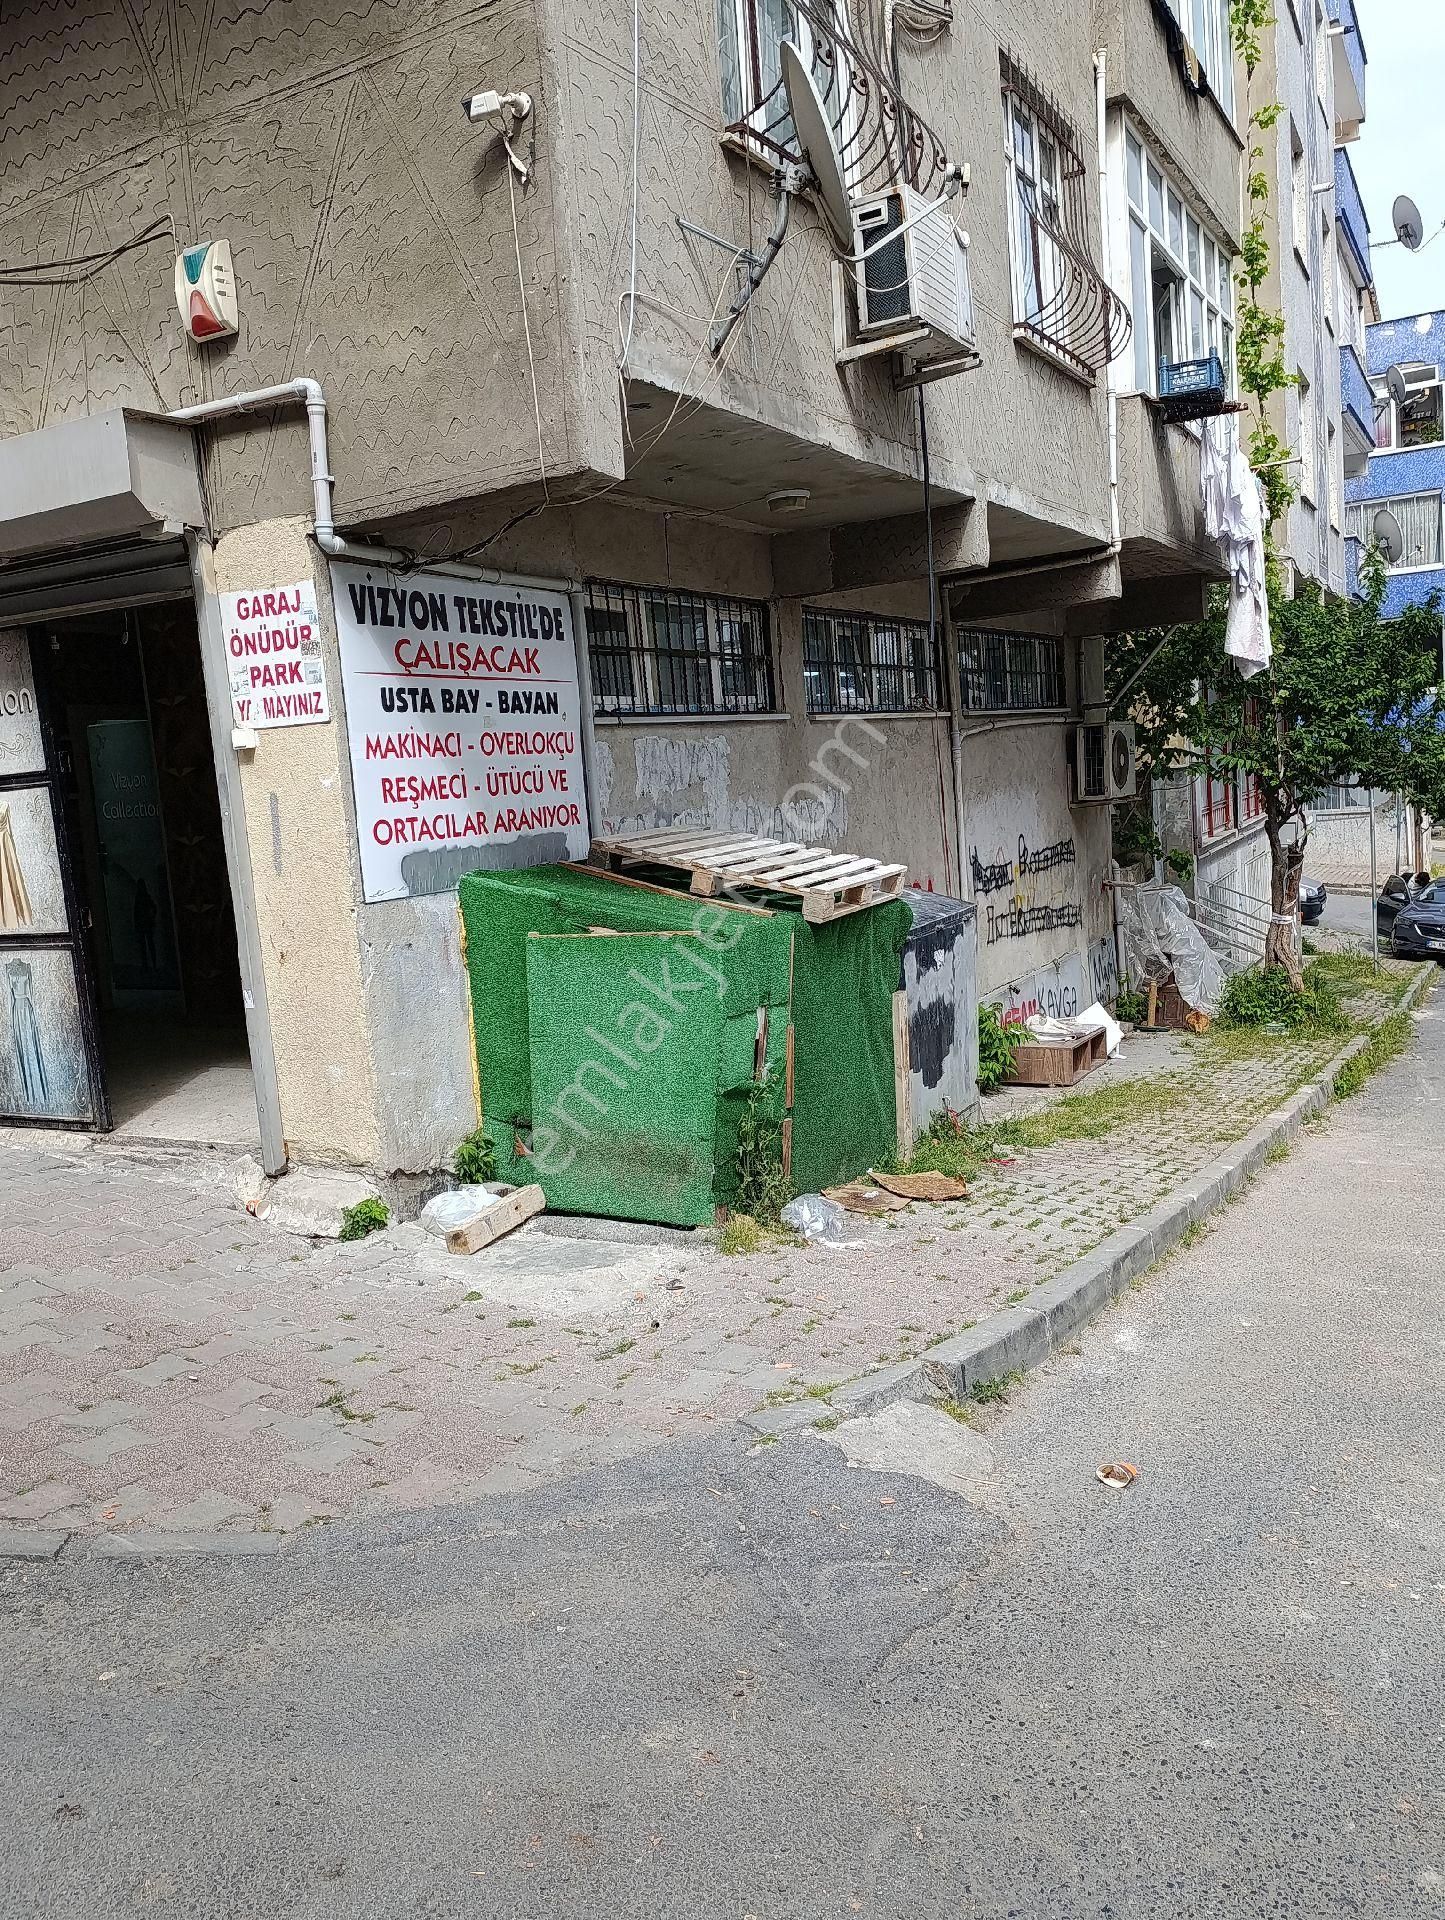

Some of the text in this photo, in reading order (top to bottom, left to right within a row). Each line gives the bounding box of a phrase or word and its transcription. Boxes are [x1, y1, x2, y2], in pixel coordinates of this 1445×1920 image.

[237, 590, 301, 620] GARAJ
[348, 572, 565, 641] VİZYON TEKSTİL'DE
[230, 620, 312, 658] ÖNÜDÜR
[250, 661, 304, 688] PARK
[394, 639, 541, 677] ÇALIŞACAK
[237, 691, 324, 721] YMAYINIZ
[380, 687, 436, 713] USTA
[441, 689, 479, 713] BAY
[498, 690, 559, 715] BAYAN
[366, 727, 462, 759] MAKİNACI
[480, 731, 575, 760] OVERLOKÇU
[381, 768, 467, 809] REŞMECİ
[487, 764, 544, 797] ÜTÜCÜ
[548, 769, 569, 792] VE
[373, 811, 489, 845] ORTACILAR
[493, 804, 581, 834] ARANIYOR
[1037, 984, 1078, 1020] KAVGA
